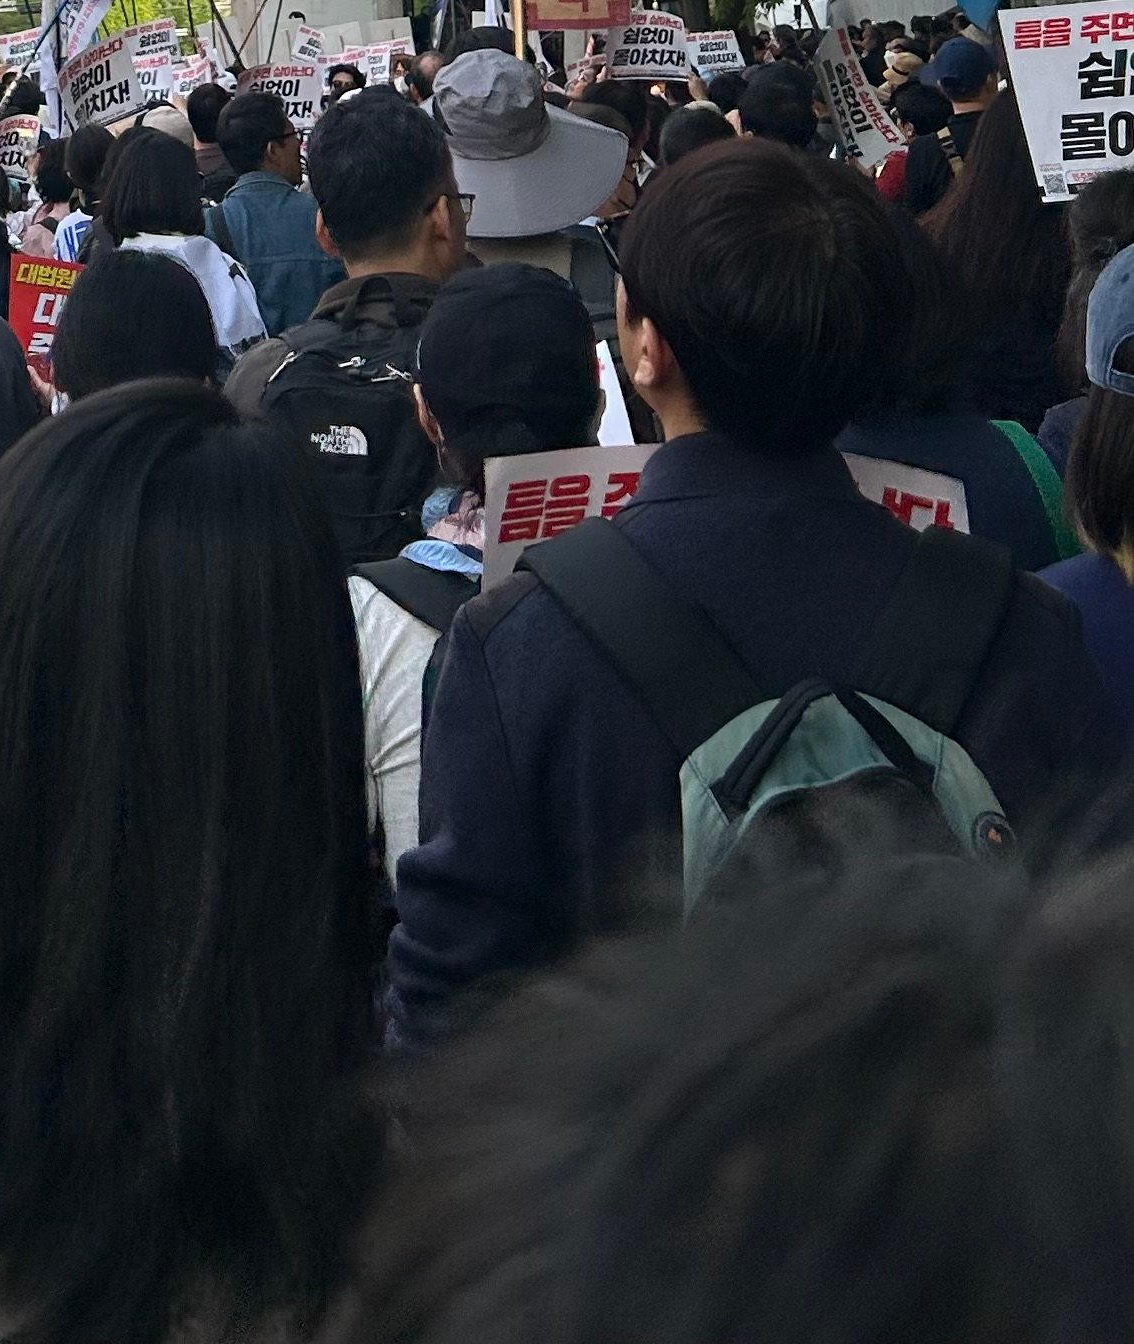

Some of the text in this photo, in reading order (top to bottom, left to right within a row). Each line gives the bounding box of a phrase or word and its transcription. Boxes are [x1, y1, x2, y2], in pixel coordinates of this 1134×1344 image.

[622, 27, 674, 46] 쉼없이
[1013, 11, 1134, 50] 틈을 주면
[612, 48, 687, 68] 몰아치자!
[310, 432, 351, 445] NORTH
[329, 424, 351, 436] THE
[319, 442, 349, 454] FACE
[497, 472, 591, 544] 틈을
